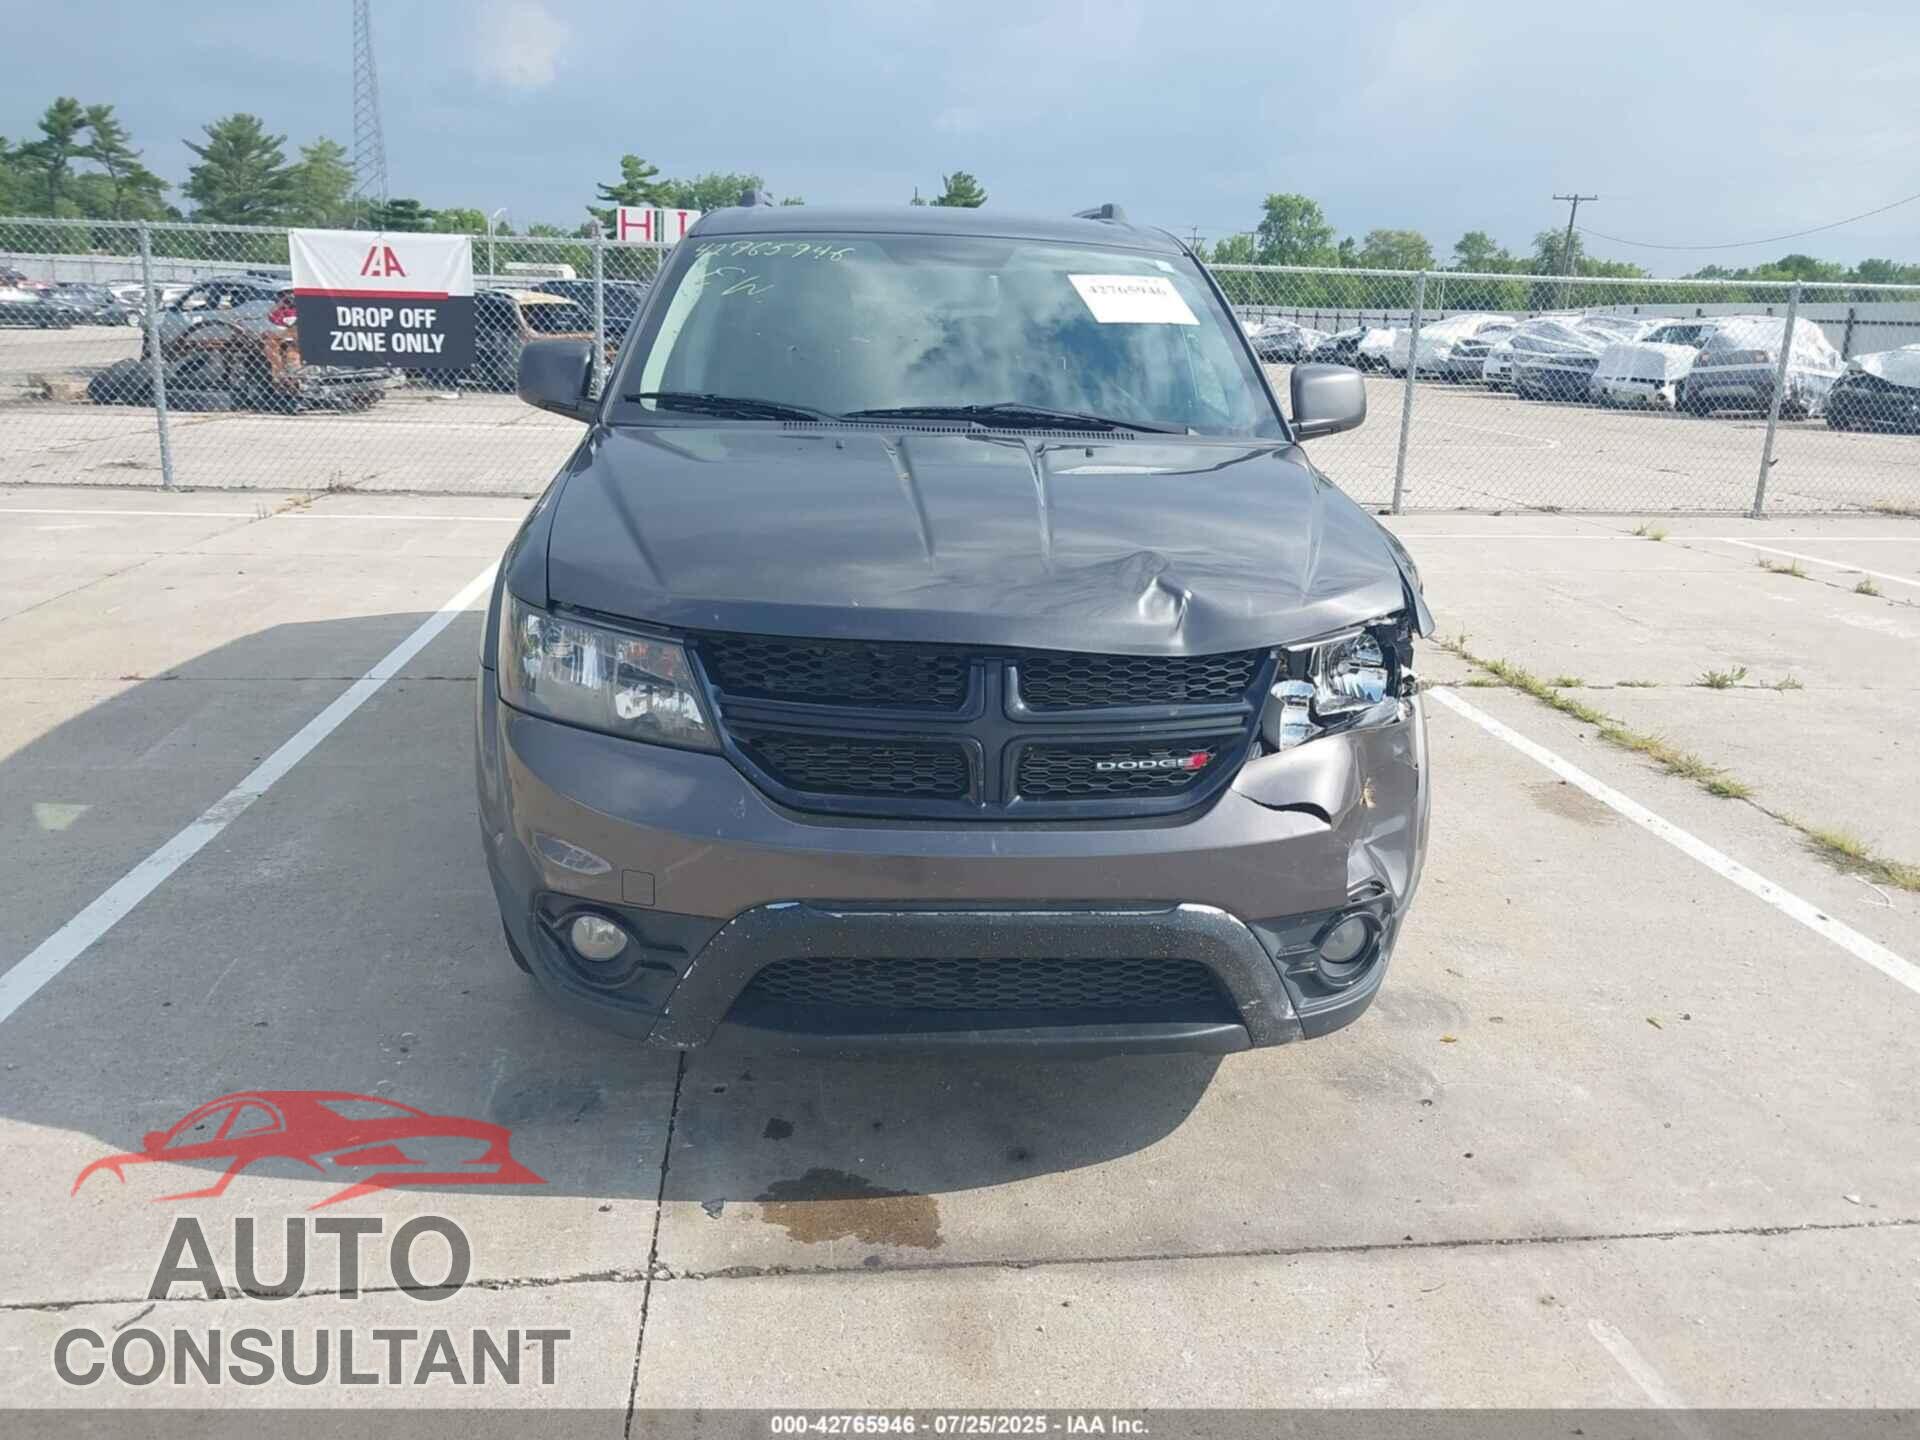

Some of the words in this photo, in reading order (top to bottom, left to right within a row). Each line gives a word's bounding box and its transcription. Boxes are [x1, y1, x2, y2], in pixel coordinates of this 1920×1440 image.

[336, 306, 393, 327] DROP
[399, 308, 436, 328] OFF
[330, 331, 386, 352] ZONE
[392, 333, 445, 353] ONLY
[1096, 757, 1192, 771] DODGE
